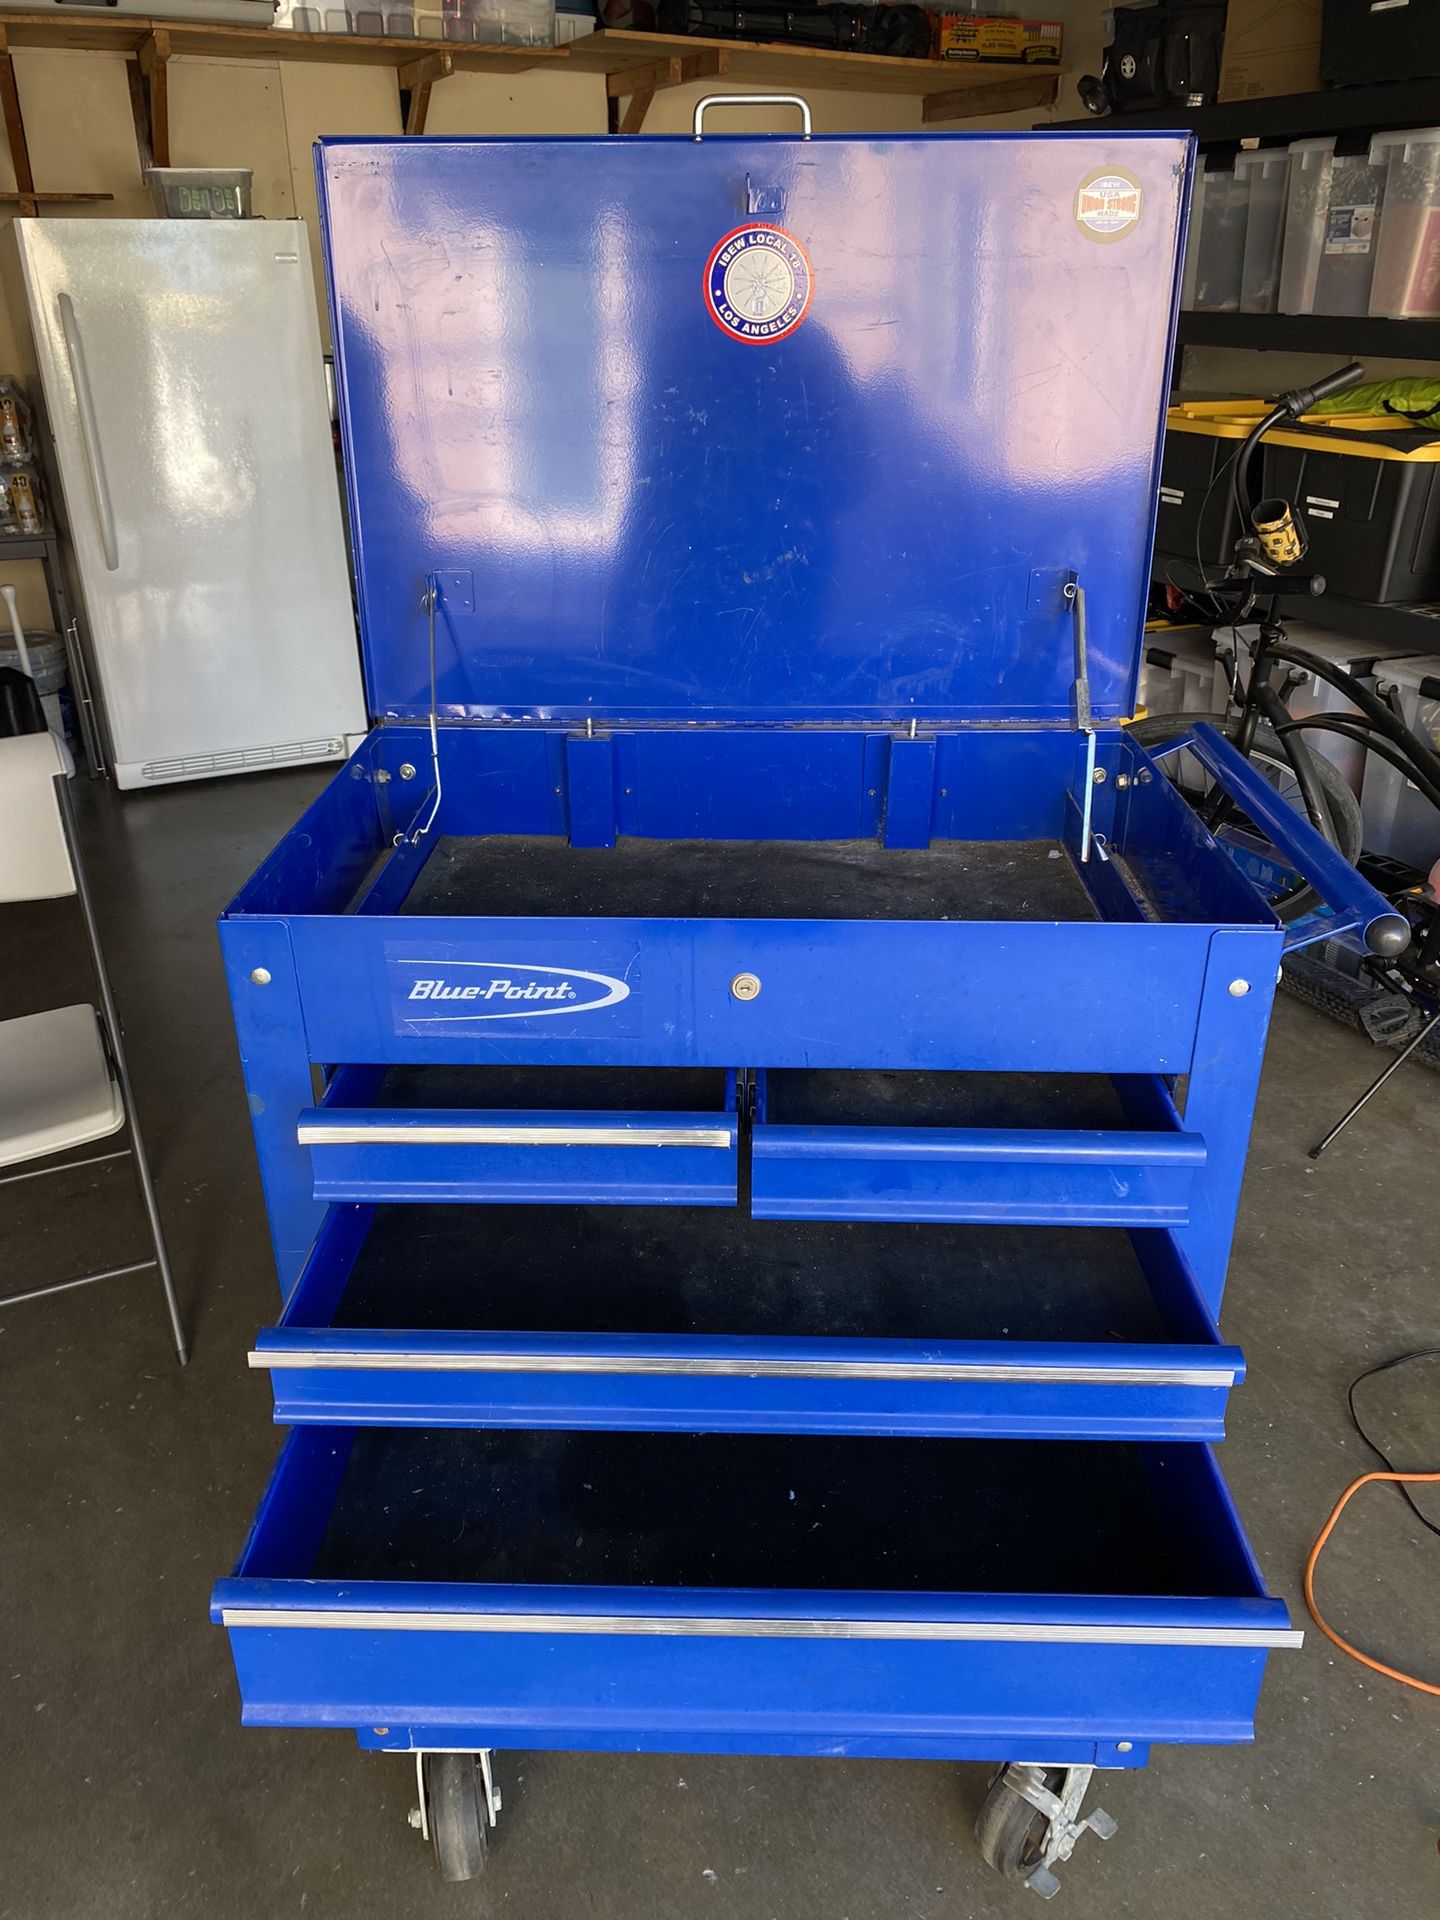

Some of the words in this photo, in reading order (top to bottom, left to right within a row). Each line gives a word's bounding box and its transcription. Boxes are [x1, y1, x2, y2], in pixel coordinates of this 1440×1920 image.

[718, 237, 746, 267] IBEW
[748, 234, 788, 253] LOCAL
[788, 253, 801, 269] 18
[719, 303, 740, 327] LOS
[741, 307, 797, 335] ANGELES
[12, 475, 27, 488] 40
